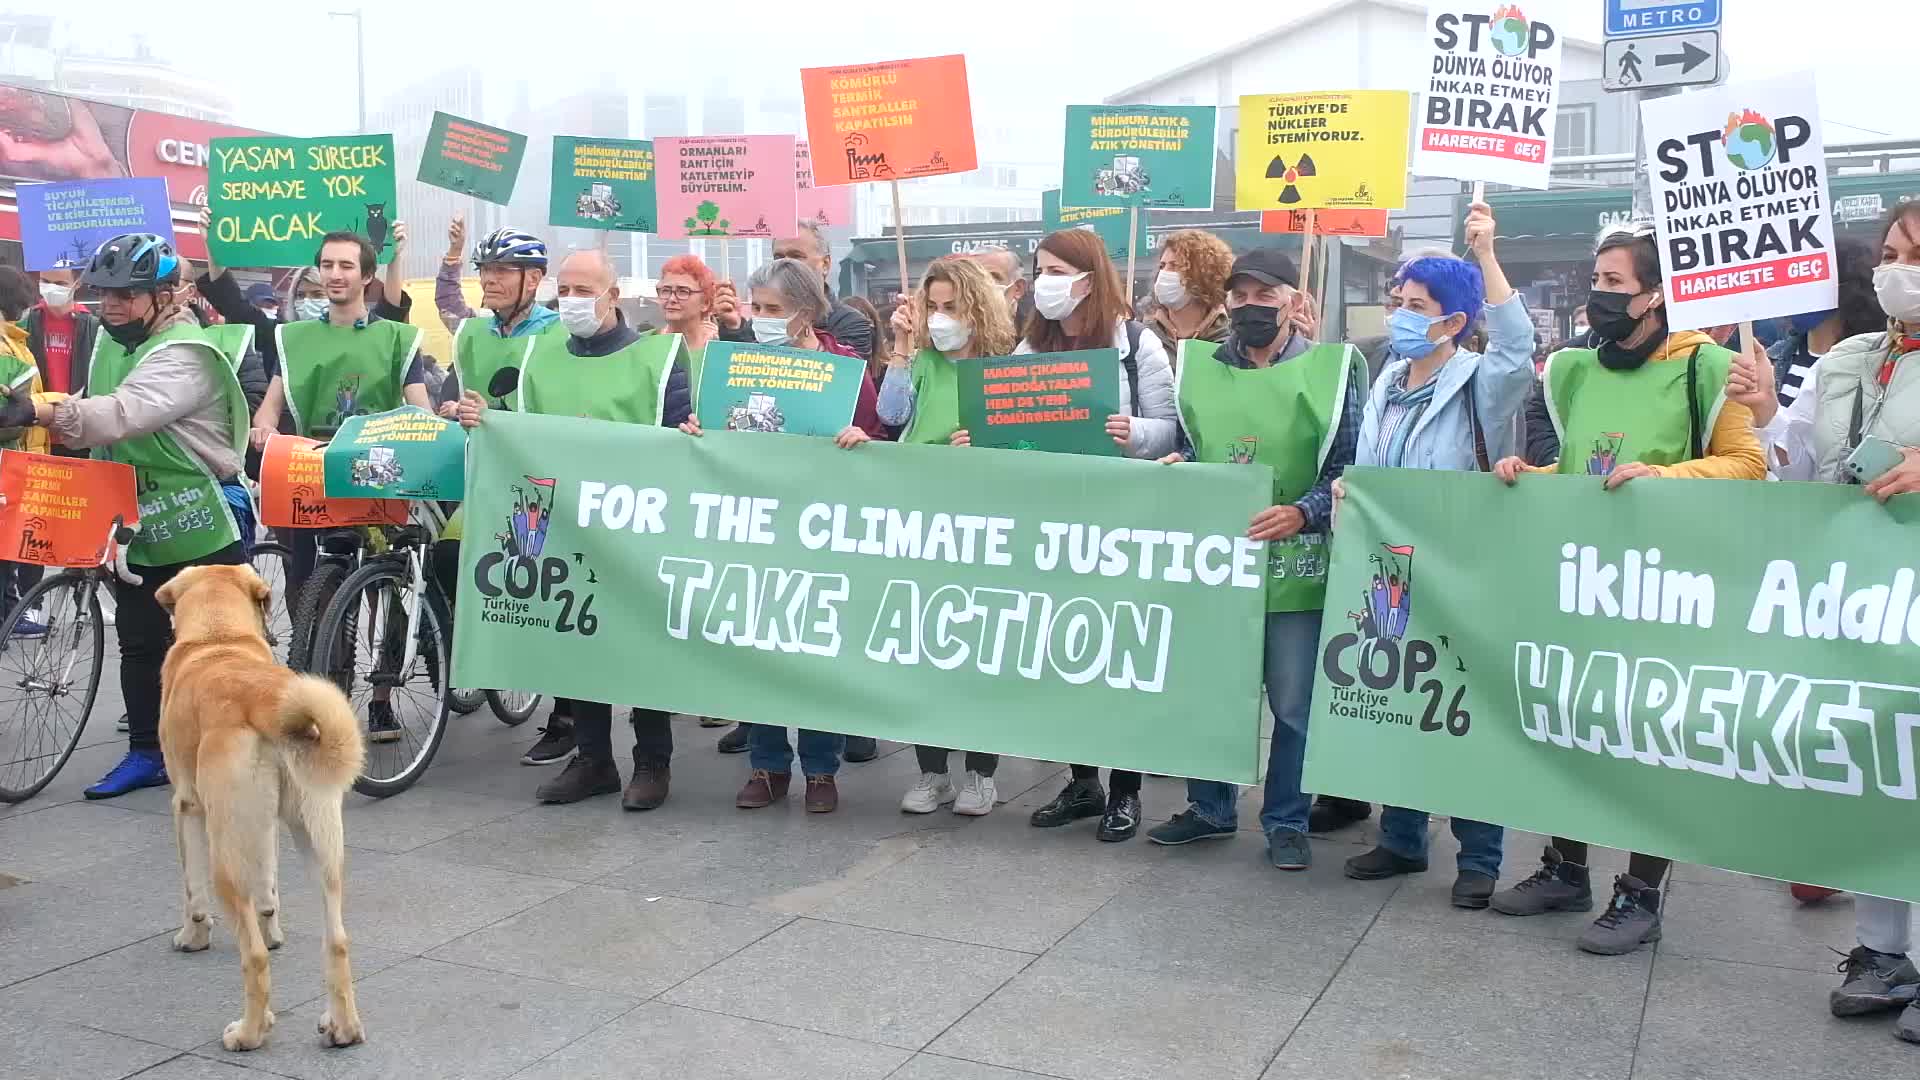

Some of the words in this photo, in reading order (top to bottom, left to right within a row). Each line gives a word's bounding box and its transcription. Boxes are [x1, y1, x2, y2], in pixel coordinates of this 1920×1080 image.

[1623, 7, 1702, 28] METRO
[1433, 12, 1555, 59] STOP
[830, 71, 897, 90] KÖMÜRLÜ
[1433, 52, 1486, 78] DÜNYA
[1491, 55, 1553, 86] ÖLÜYOR
[831, 88, 883, 104] TERMİK
[1430, 76, 1485, 95] İNKAR
[1490, 84, 1550, 104] ETMEYİ
[832, 100, 918, 118] SANTRALLER
[1091, 114, 1148, 126] MİNİMUM
[1151, 117, 1178, 126] ATIK
[1268, 102, 1348, 116] TÜRKİYE'DE
[1426, 96, 1548, 136] BIRAK
[835, 114, 913, 133] KAPATILSIN
[1268, 117, 1326, 130] NÜKLEER
[1090, 141, 1118, 151] ATIK
[1121, 137, 1183, 151] YÖNETİMİ
[1267, 129, 1364, 144] İSTEMİYORUZ.
[1428, 133, 1504, 152] HAREKETE
[1514, 141, 1541, 160] GEÇ
[307, 144, 387, 171] SÜRECEK
[680, 146, 747, 157] ORMANLARI
[1656, 115, 1810, 183] STOP
[680, 159, 709, 169] RANT
[711, 156, 734, 171] İÇİN
[680, 168, 755, 181] KATLETMEYİP
[220, 180, 307, 201] SERMAYE
[322, 175, 367, 198] YOK
[681, 181, 748, 193] BÜYÜTELİM.
[1664, 180, 1731, 213] DÜNYA
[1736, 165, 1818, 200] ÖLÜYOR
[1667, 210, 1733, 234] İNKAR
[1741, 191, 1820, 221] ETMEYİ
[217, 211, 328, 243] OLACAK
[1669, 214, 1824, 272] BIRAK
[1680, 266, 1775, 295] HAREKETE
[1787, 259, 1823, 280] GEÇ
[728, 363, 833, 382] SÜRDÜRÜLEBİLİR
[730, 352, 792, 366] MİNİMUM
[793, 357, 824, 370] ATIK
[726, 377, 755, 388] ATIK
[760, 377, 823, 392] YÖNETİMİ
[577, 480, 668, 534] FOR
[689, 492, 779, 545] THE
[798, 503, 1014, 567] CLIMATE
[1034, 521, 1265, 589] JUSTICE
[474, 552, 569, 601] COP
[555, 589, 599, 636] 26
[1559, 542, 1715, 629] iklim
[483, 597, 529, 614] Türkiye
[481, 611, 550, 629] Koalisyonu
[658, 556, 850, 657] TAKE
[865, 579, 1173, 692] ACTION
[1323, 634, 1437, 693] COP
[1419, 680, 1471, 737] 26
[1331, 685, 1389, 707] Türkiye
[1329, 701, 1413, 727] Koalisyonu
[1514, 641, 1920, 800] HAREKET
